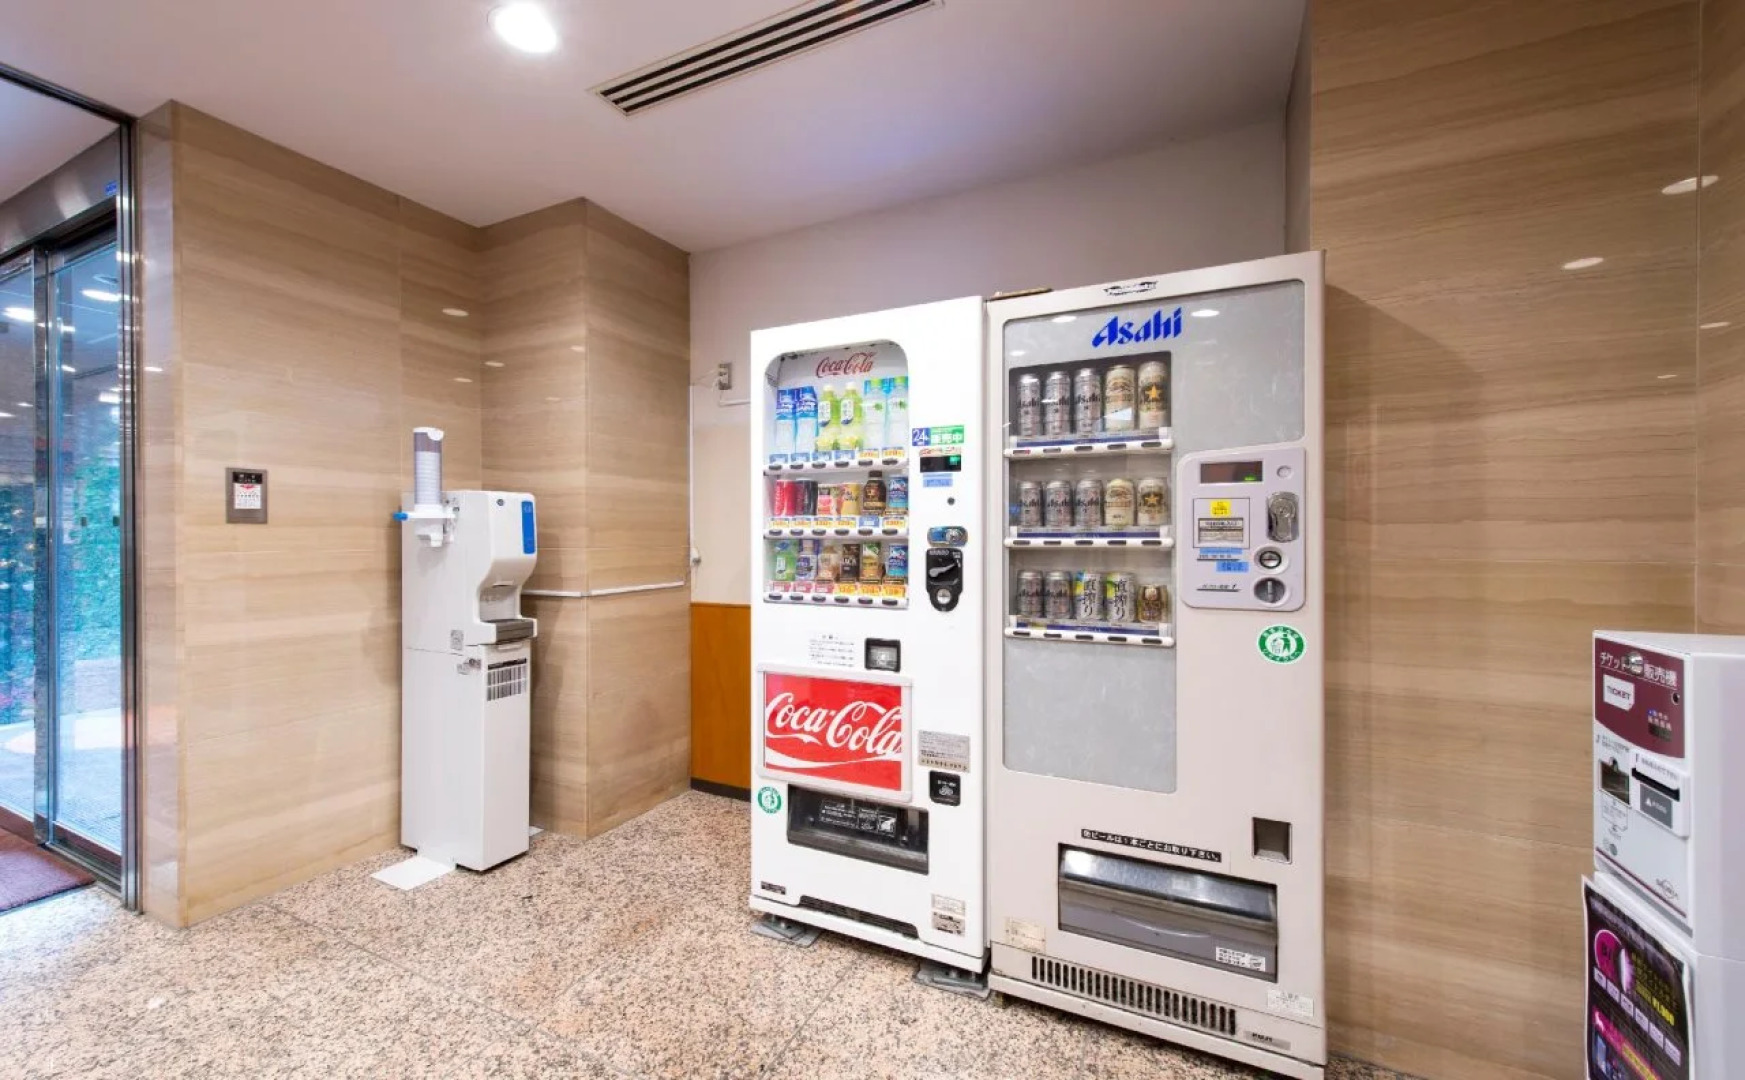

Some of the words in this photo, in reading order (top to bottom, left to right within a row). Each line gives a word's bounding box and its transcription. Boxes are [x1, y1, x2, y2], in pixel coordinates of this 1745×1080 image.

[1092, 307, 1182, 348] Asahi
[815, 352, 878, 378] Coca-Cola
[764, 692, 902, 755] Coca-Cola
